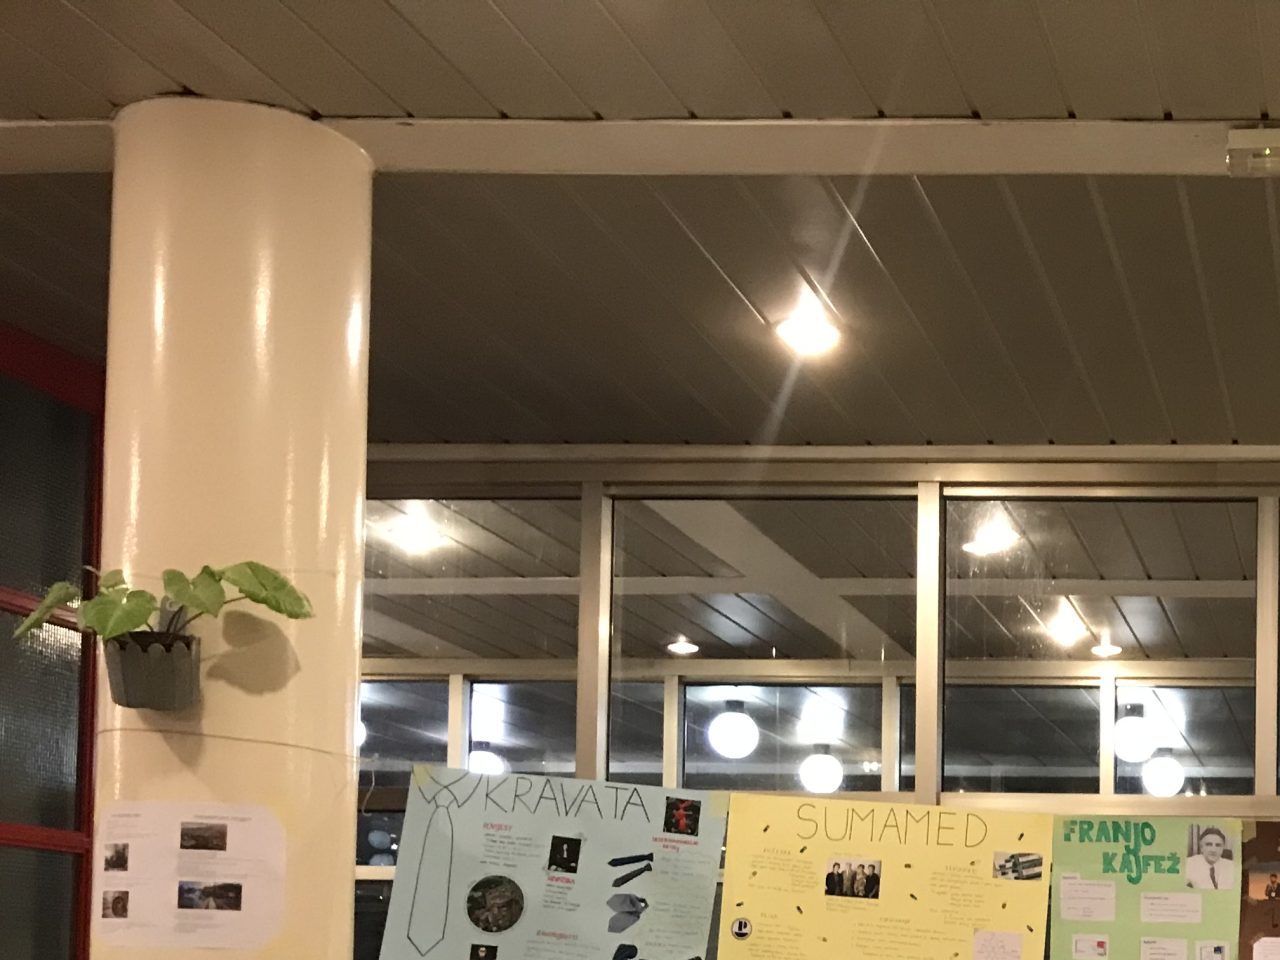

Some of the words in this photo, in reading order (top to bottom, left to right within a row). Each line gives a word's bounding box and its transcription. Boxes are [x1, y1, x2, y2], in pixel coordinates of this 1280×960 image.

[484, 776, 650, 823] KRAVATA
[796, 803, 988, 848] SUMAMED
[1063, 820, 1156, 855] FRANJO
[1102, 851, 1181, 885] KAJFEŽ
